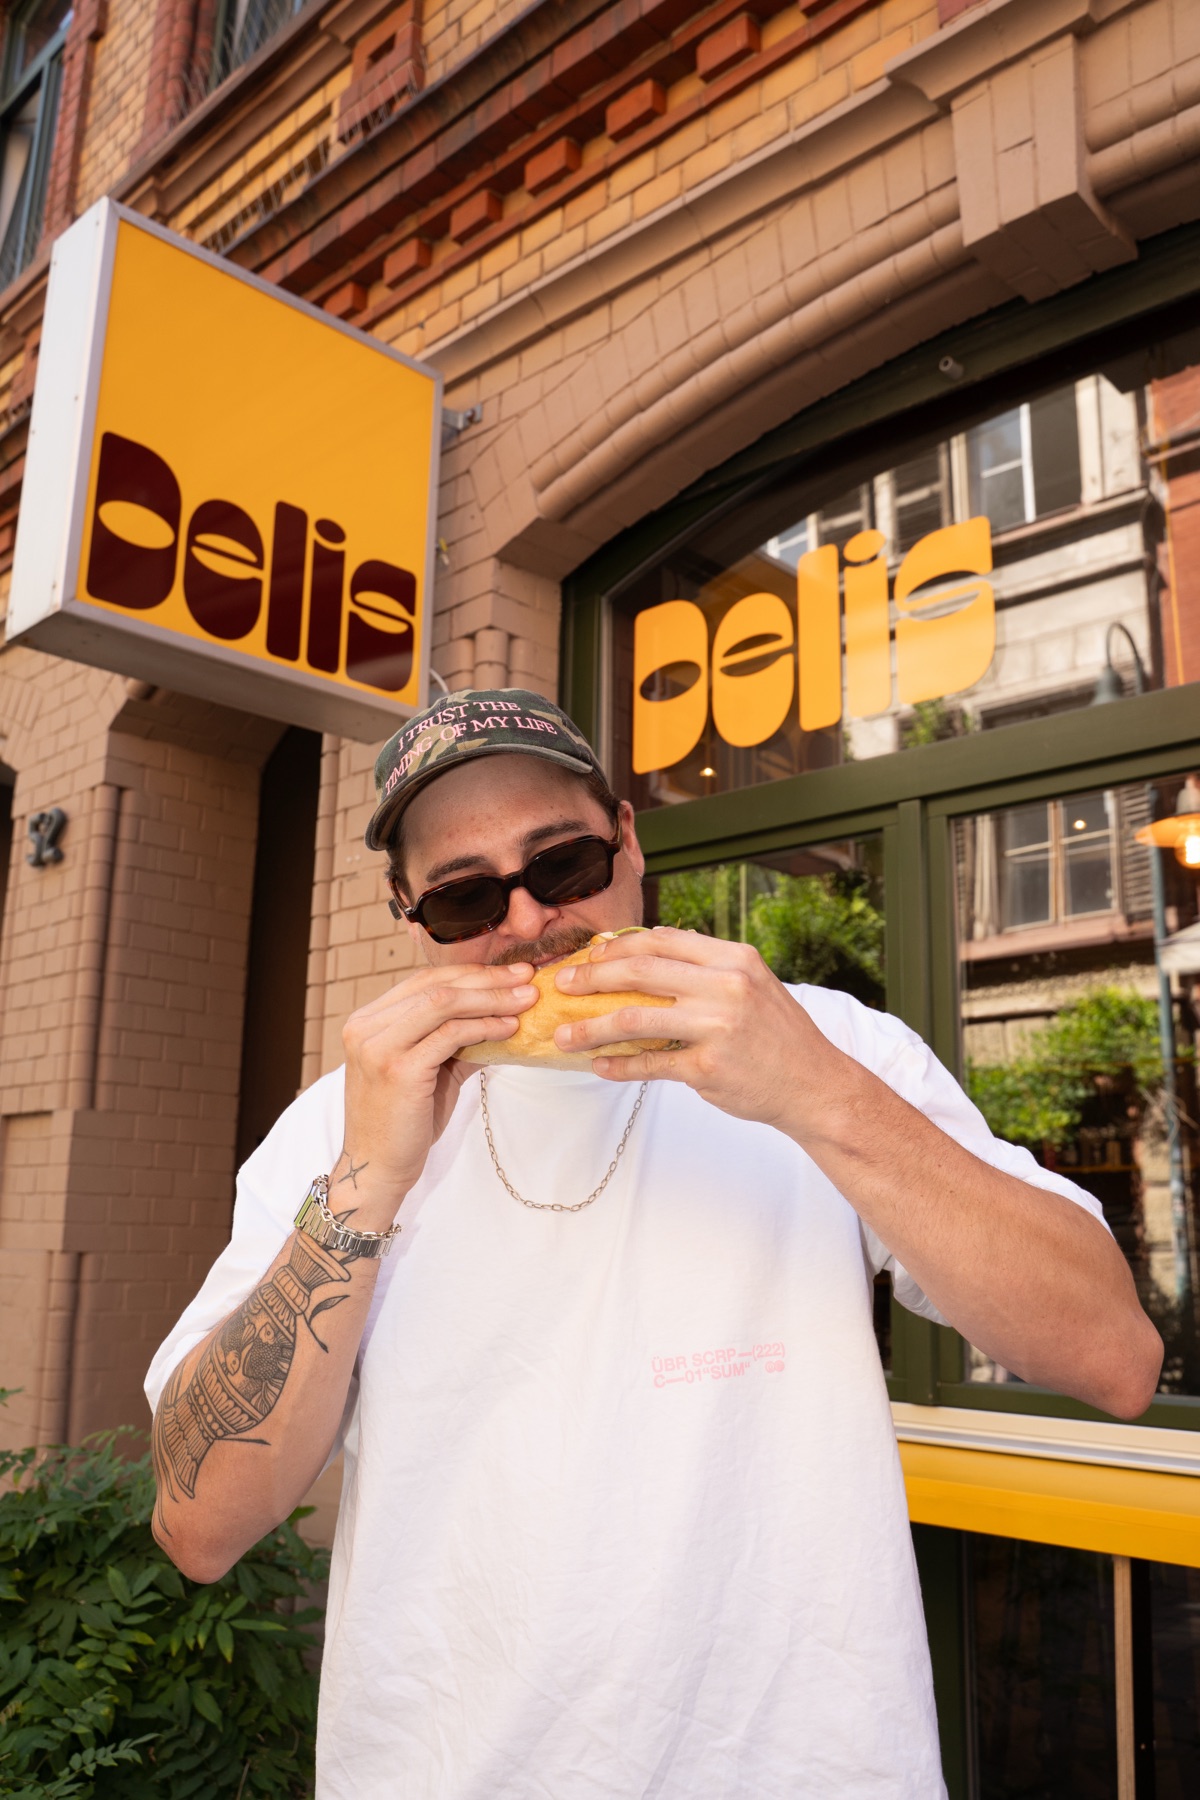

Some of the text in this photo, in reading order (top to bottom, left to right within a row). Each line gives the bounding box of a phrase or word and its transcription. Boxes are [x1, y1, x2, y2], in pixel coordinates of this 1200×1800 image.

[86, 431, 416, 693] Delis
[633, 516, 995, 775] Delis
[385, 716, 558, 796] TIMING OF MY LIFE
[397, 701, 522, 752] I TRUST THE
[651, 1355, 688, 1374] ÜBR
